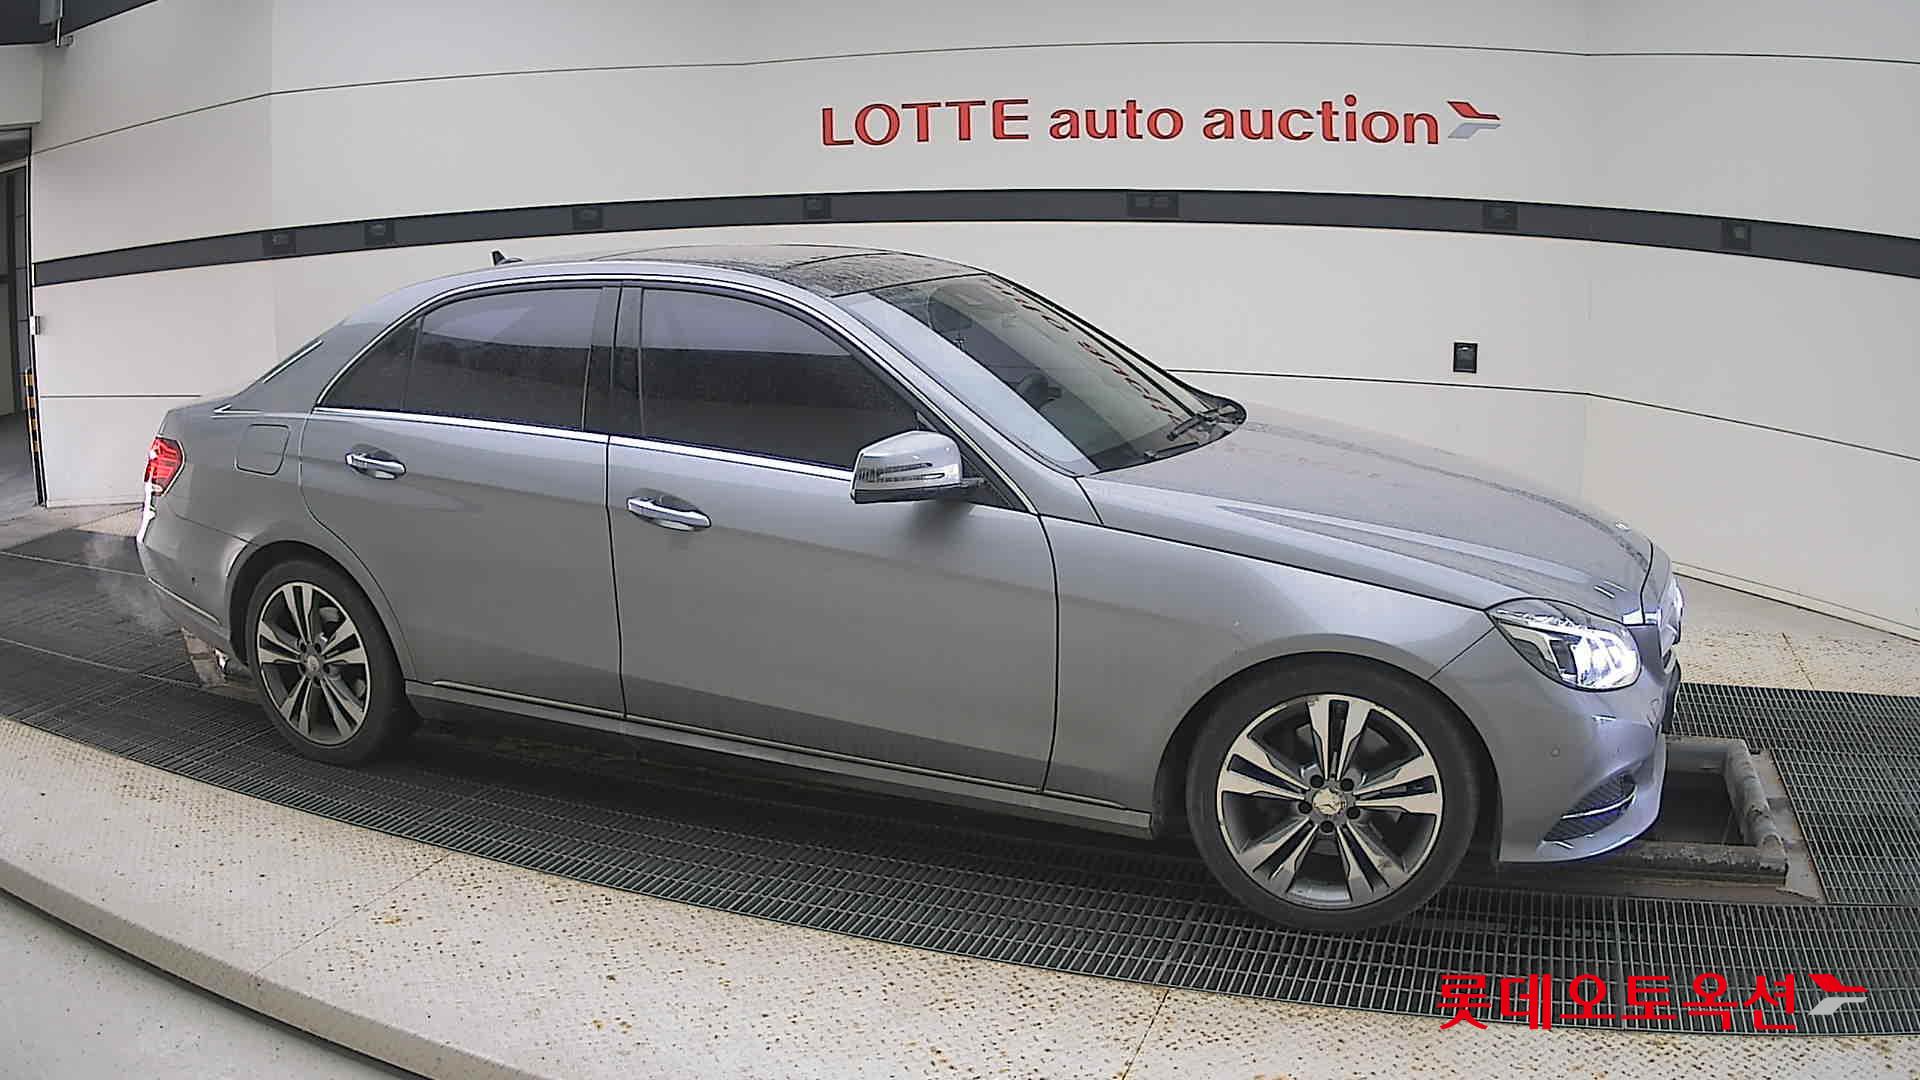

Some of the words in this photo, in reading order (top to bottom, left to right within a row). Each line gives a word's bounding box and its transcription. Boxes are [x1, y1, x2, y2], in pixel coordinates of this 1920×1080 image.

[821, 98, 1030, 146] LOTTE
[1049, 99, 1186, 140] auto
[1203, 94, 1440, 145] auction
